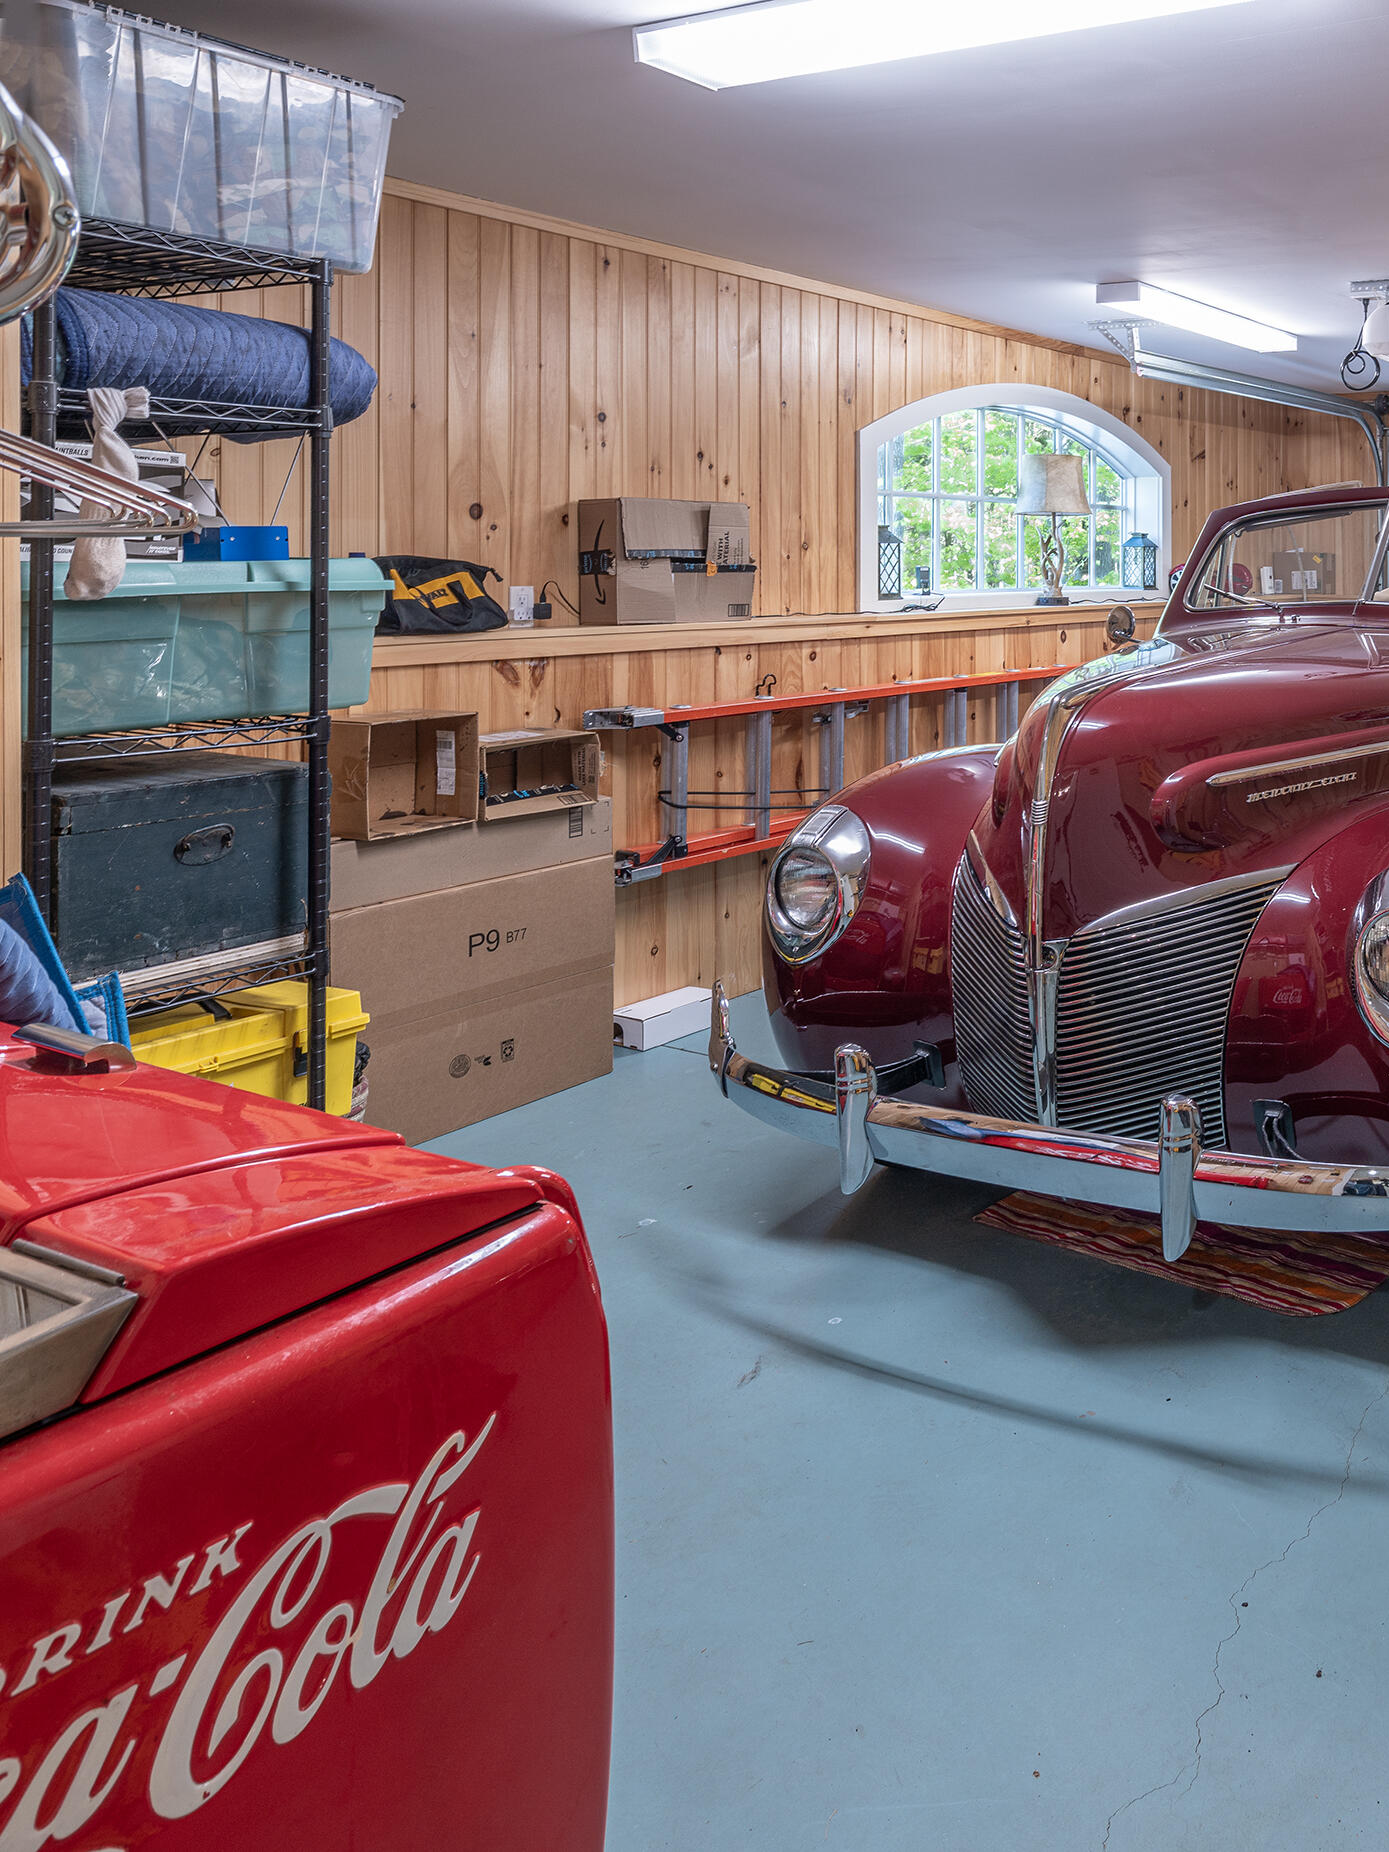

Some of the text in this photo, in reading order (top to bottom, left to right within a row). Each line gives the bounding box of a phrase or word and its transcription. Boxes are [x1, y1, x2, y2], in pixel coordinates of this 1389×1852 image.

[468, 927, 527, 957] P9 B77
[0, 1411, 496, 1852] a-Cola
